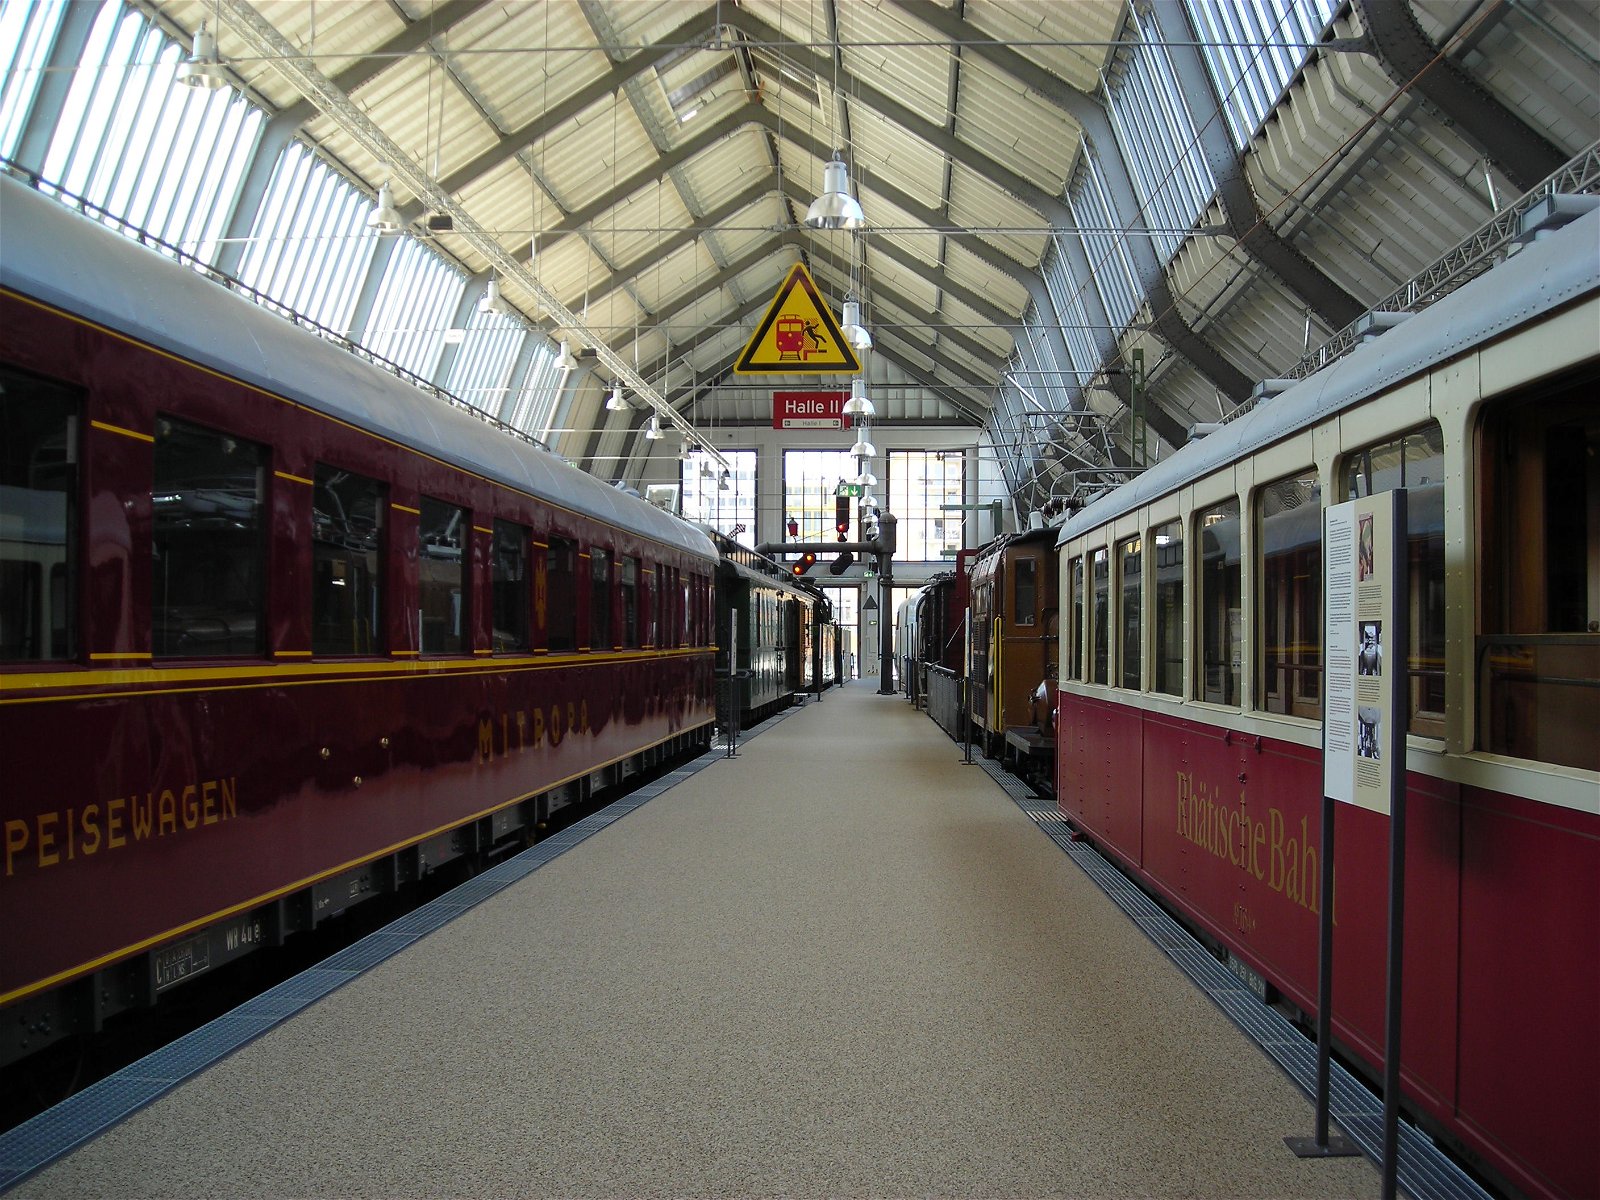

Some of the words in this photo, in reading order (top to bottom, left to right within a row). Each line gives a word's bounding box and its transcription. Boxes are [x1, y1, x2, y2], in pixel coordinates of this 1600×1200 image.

[785, 399, 825, 414] Halle
[830, 399, 839, 414] II
[478, 698, 589, 765] MITROPA
[4, 776, 237, 877] PEISEWAGEN
[1176, 770, 1266, 880] Rhätische
